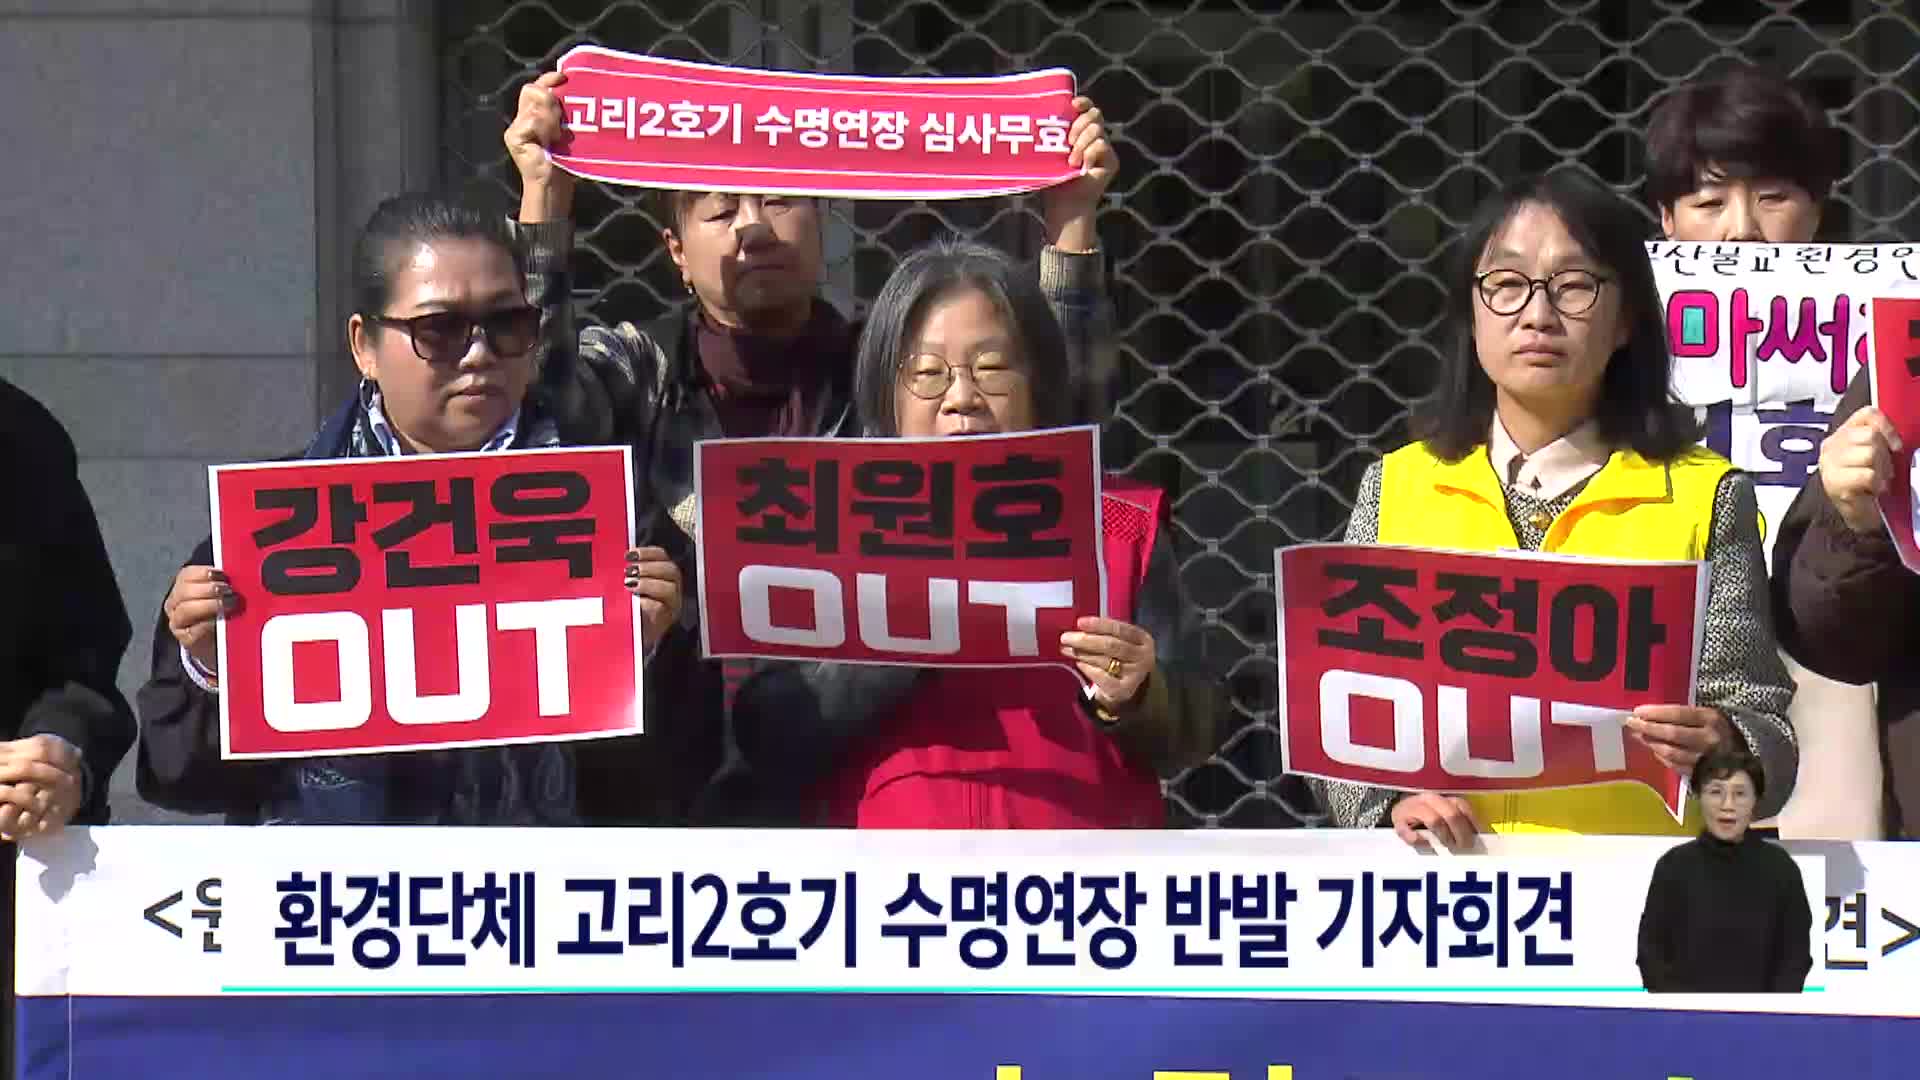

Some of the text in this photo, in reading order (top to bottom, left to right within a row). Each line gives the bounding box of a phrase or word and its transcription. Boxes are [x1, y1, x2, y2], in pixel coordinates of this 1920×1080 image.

[564, 95, 1072, 154] 고리2호기 수명연장 심사무효
[250, 470, 597, 595] 강건욱
[735, 454, 1073, 560] 최원호
[260, 596, 604, 733] OUT
[738, 564, 1074, 657] OUT
[1316, 563, 1668, 691] 조정아
[1319, 668, 1636, 779] OUT
